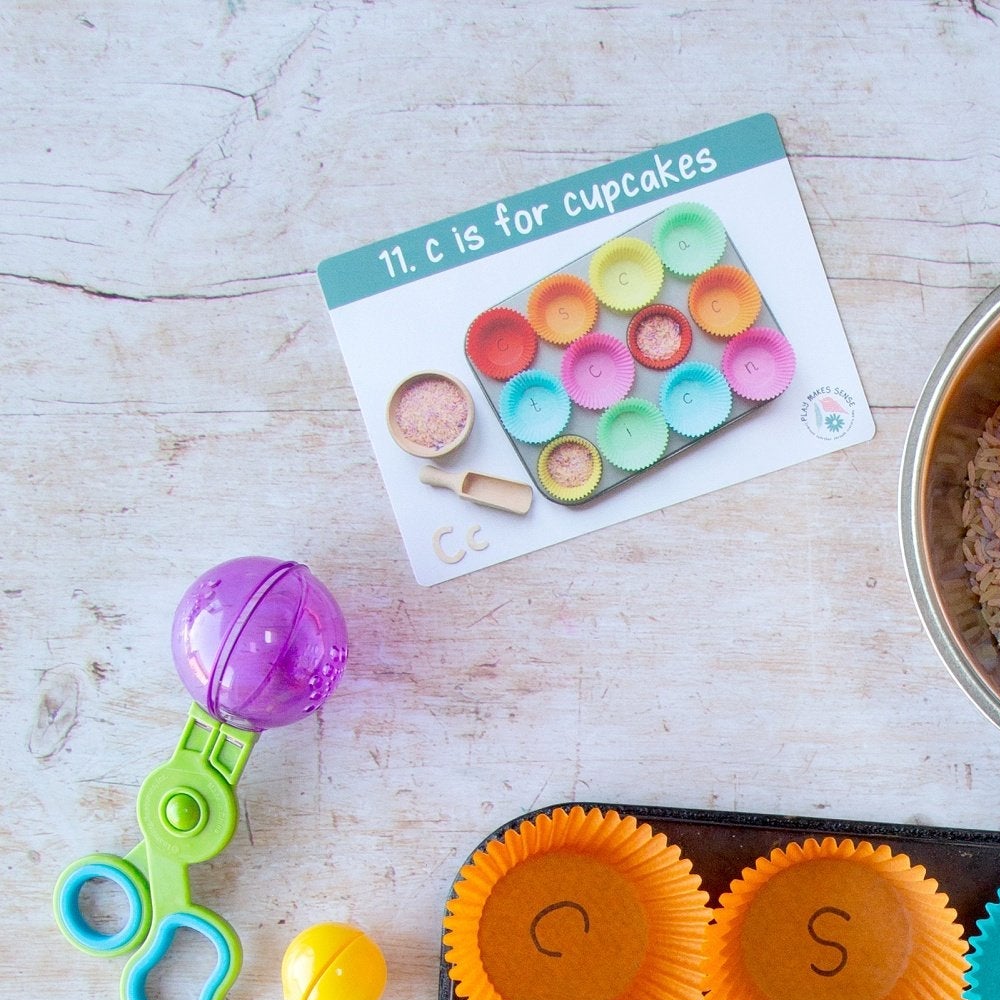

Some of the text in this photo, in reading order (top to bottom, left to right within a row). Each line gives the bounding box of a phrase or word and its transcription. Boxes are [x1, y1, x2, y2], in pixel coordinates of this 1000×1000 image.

[378, 147, 718, 278] 11. c is for cupcakes
[800, 385, 856, 422] PLAY MAKES SENSE
